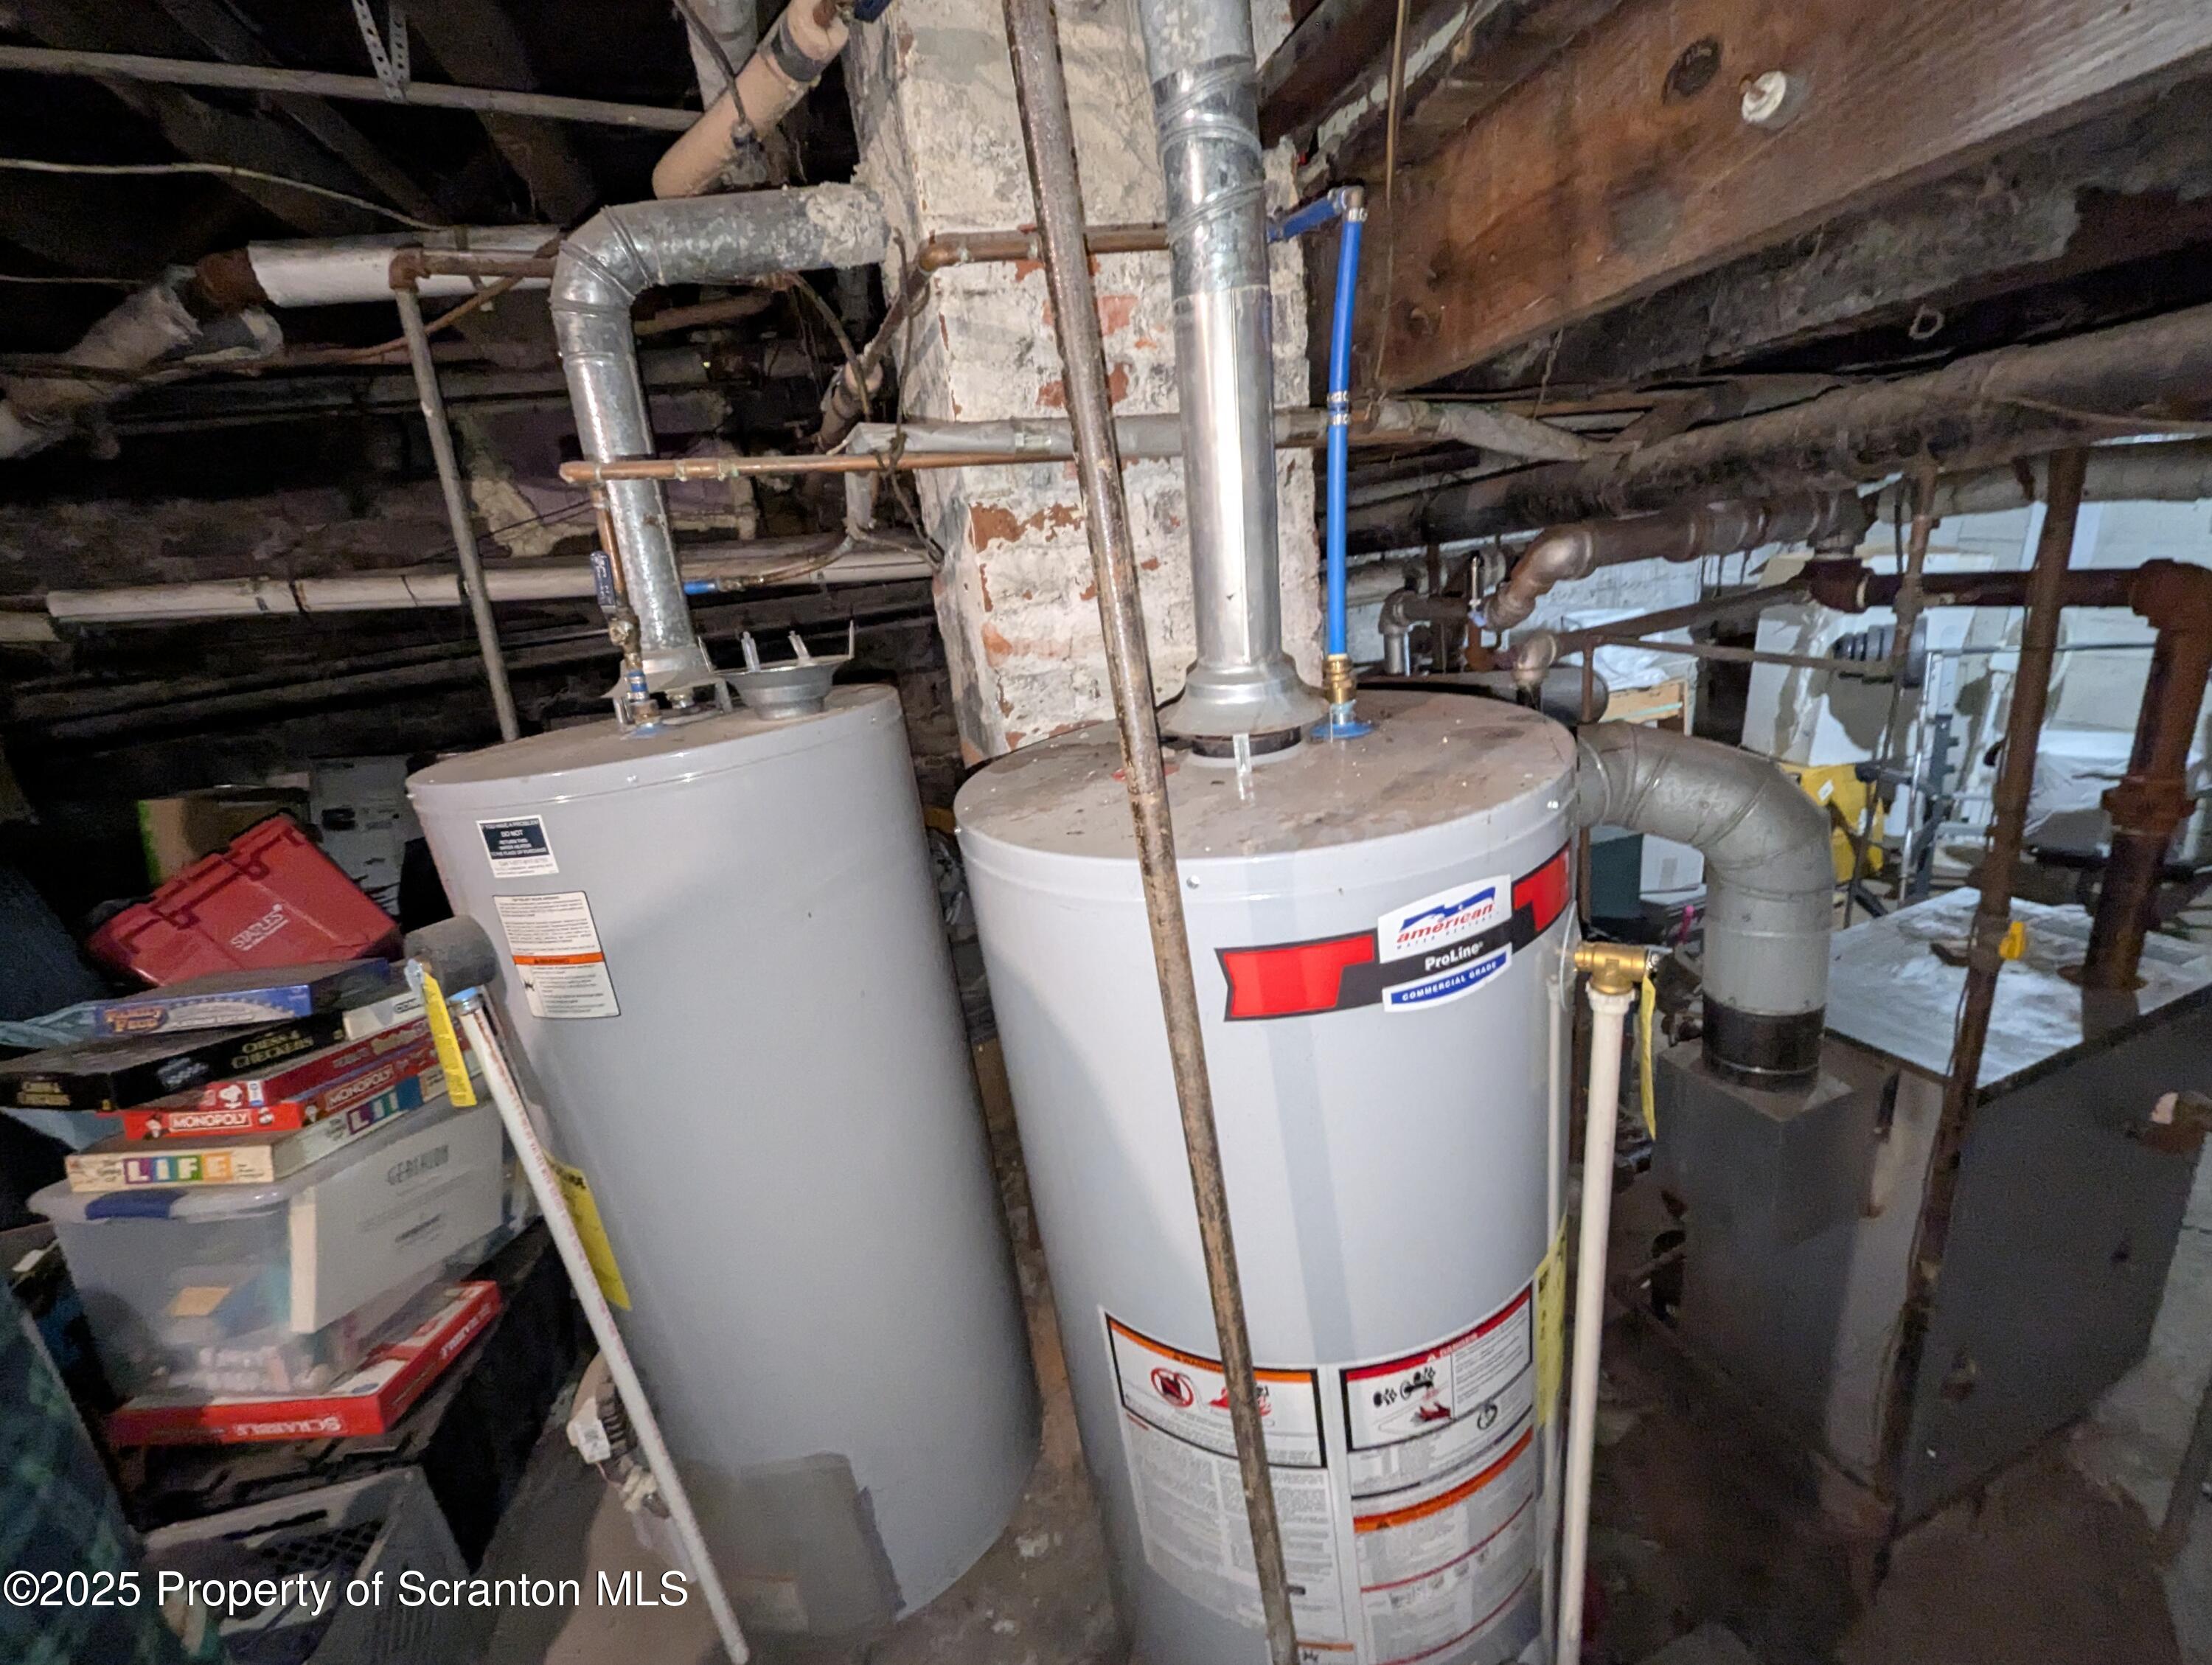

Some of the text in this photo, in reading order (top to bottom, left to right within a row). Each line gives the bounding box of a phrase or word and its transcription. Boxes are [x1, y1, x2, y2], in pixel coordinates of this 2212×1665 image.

[230, 909, 284, 948] STAPLES
[1397, 903, 1494, 944] american
[1402, 961, 1498, 1001] COMMERCIAL GRADE
[231, 1035, 314, 1069] CHECKERS
[242, 1034, 288, 1054] CHESS
[329, 1068, 394, 1104] MONOPOLY
[172, 1112, 251, 1129] MONOPOLY
[125, 1155, 230, 1182] LIFE
